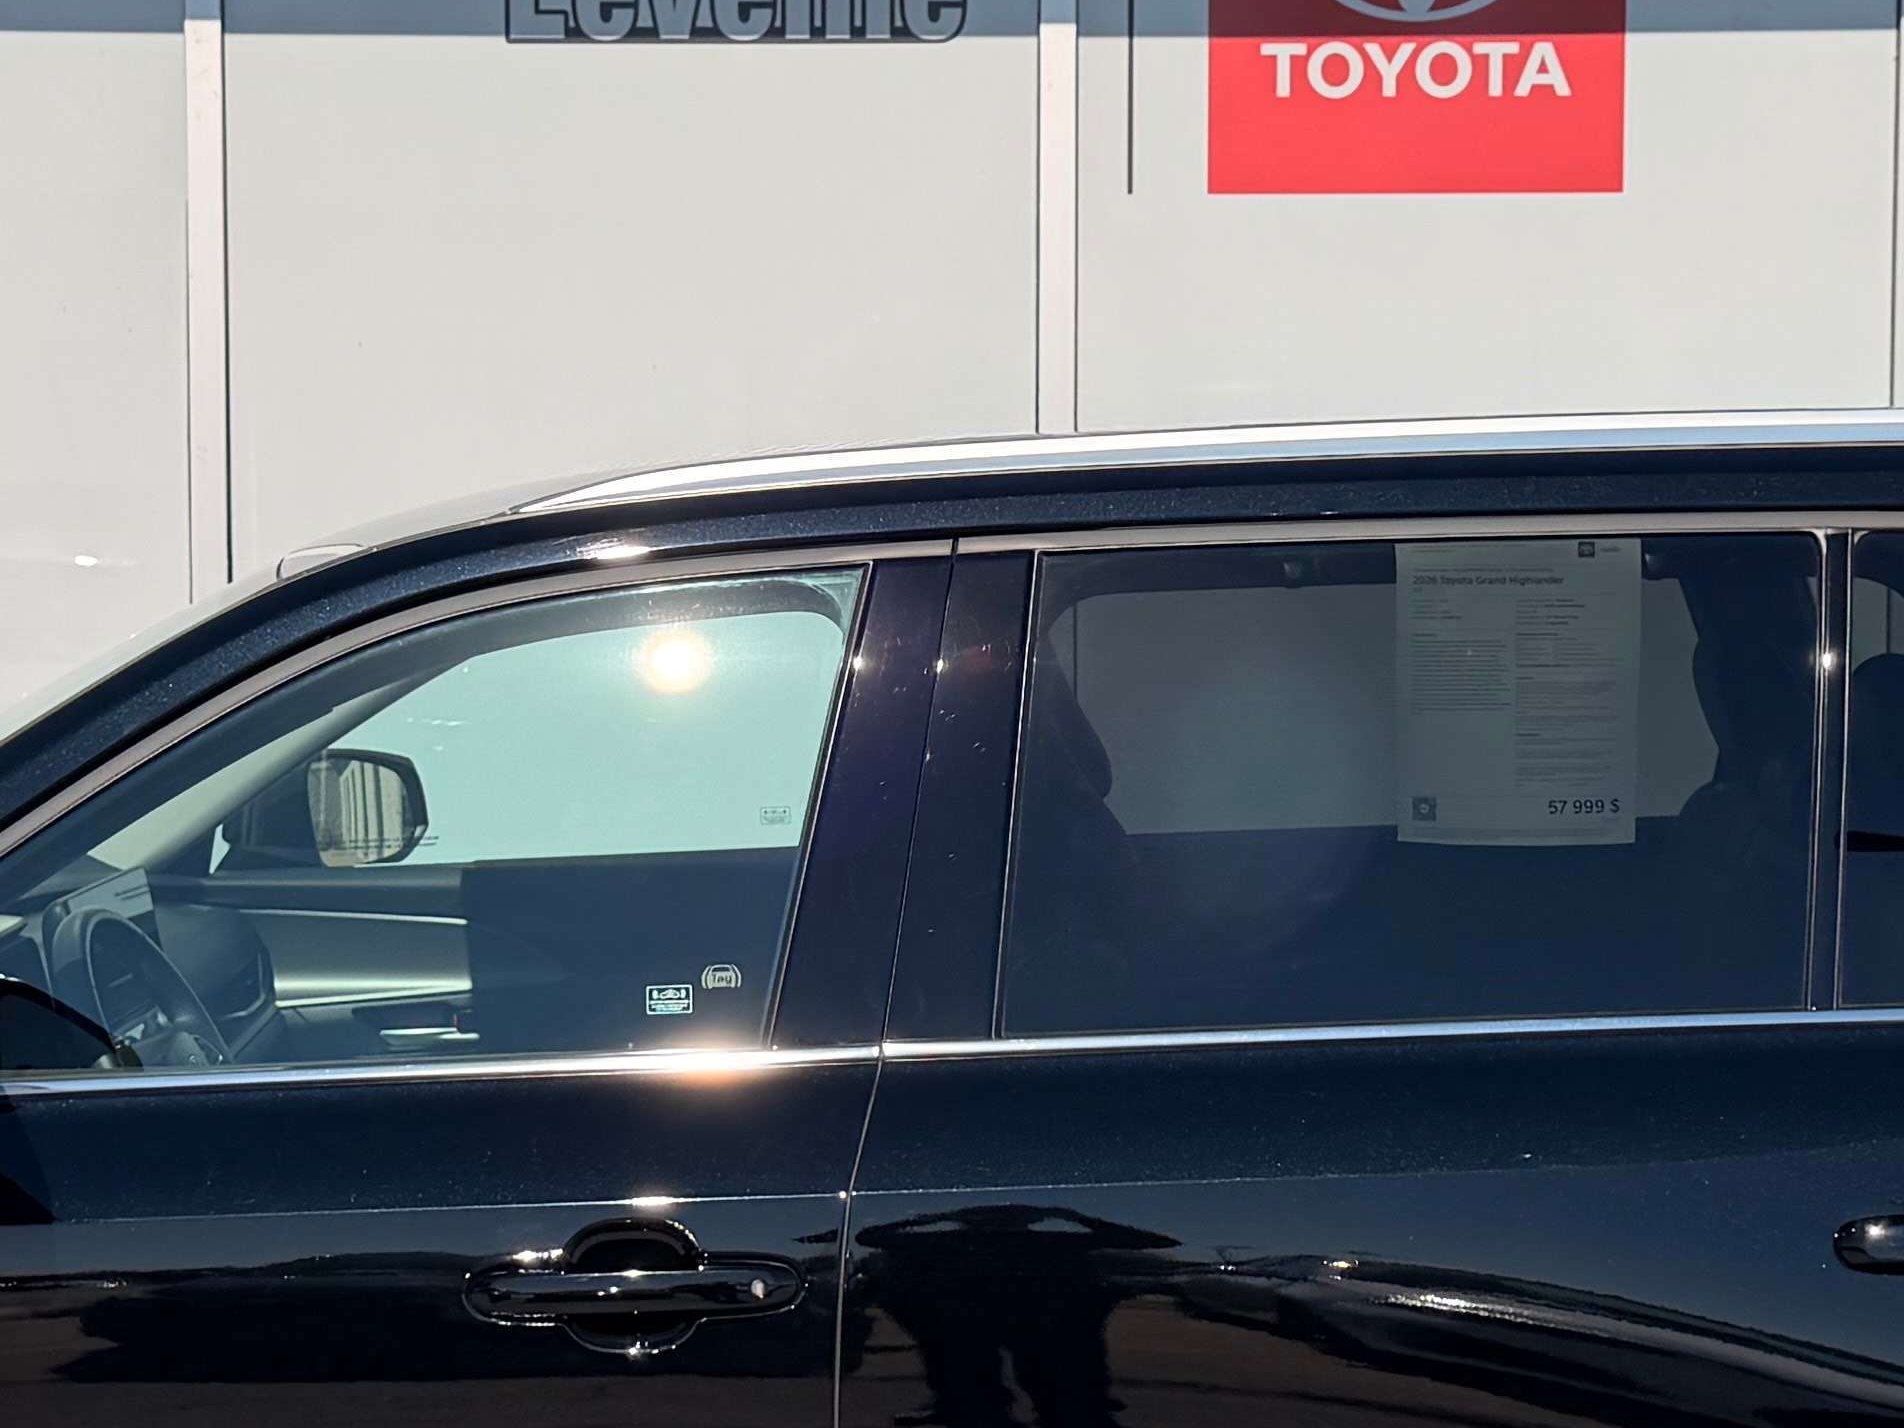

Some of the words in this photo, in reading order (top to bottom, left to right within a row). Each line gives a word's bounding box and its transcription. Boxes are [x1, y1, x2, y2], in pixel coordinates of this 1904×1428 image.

[1259, 40, 1572, 101] TOYOTA
[1439, 574, 1474, 588] Toyota
[1475, 574, 1507, 586] Grand
[1509, 573, 1564, 588] Highlander
[1547, 799, 1568, 815] 57
[1572, 798, 1605, 815] 999
[1609, 797, 1621, 815] $
